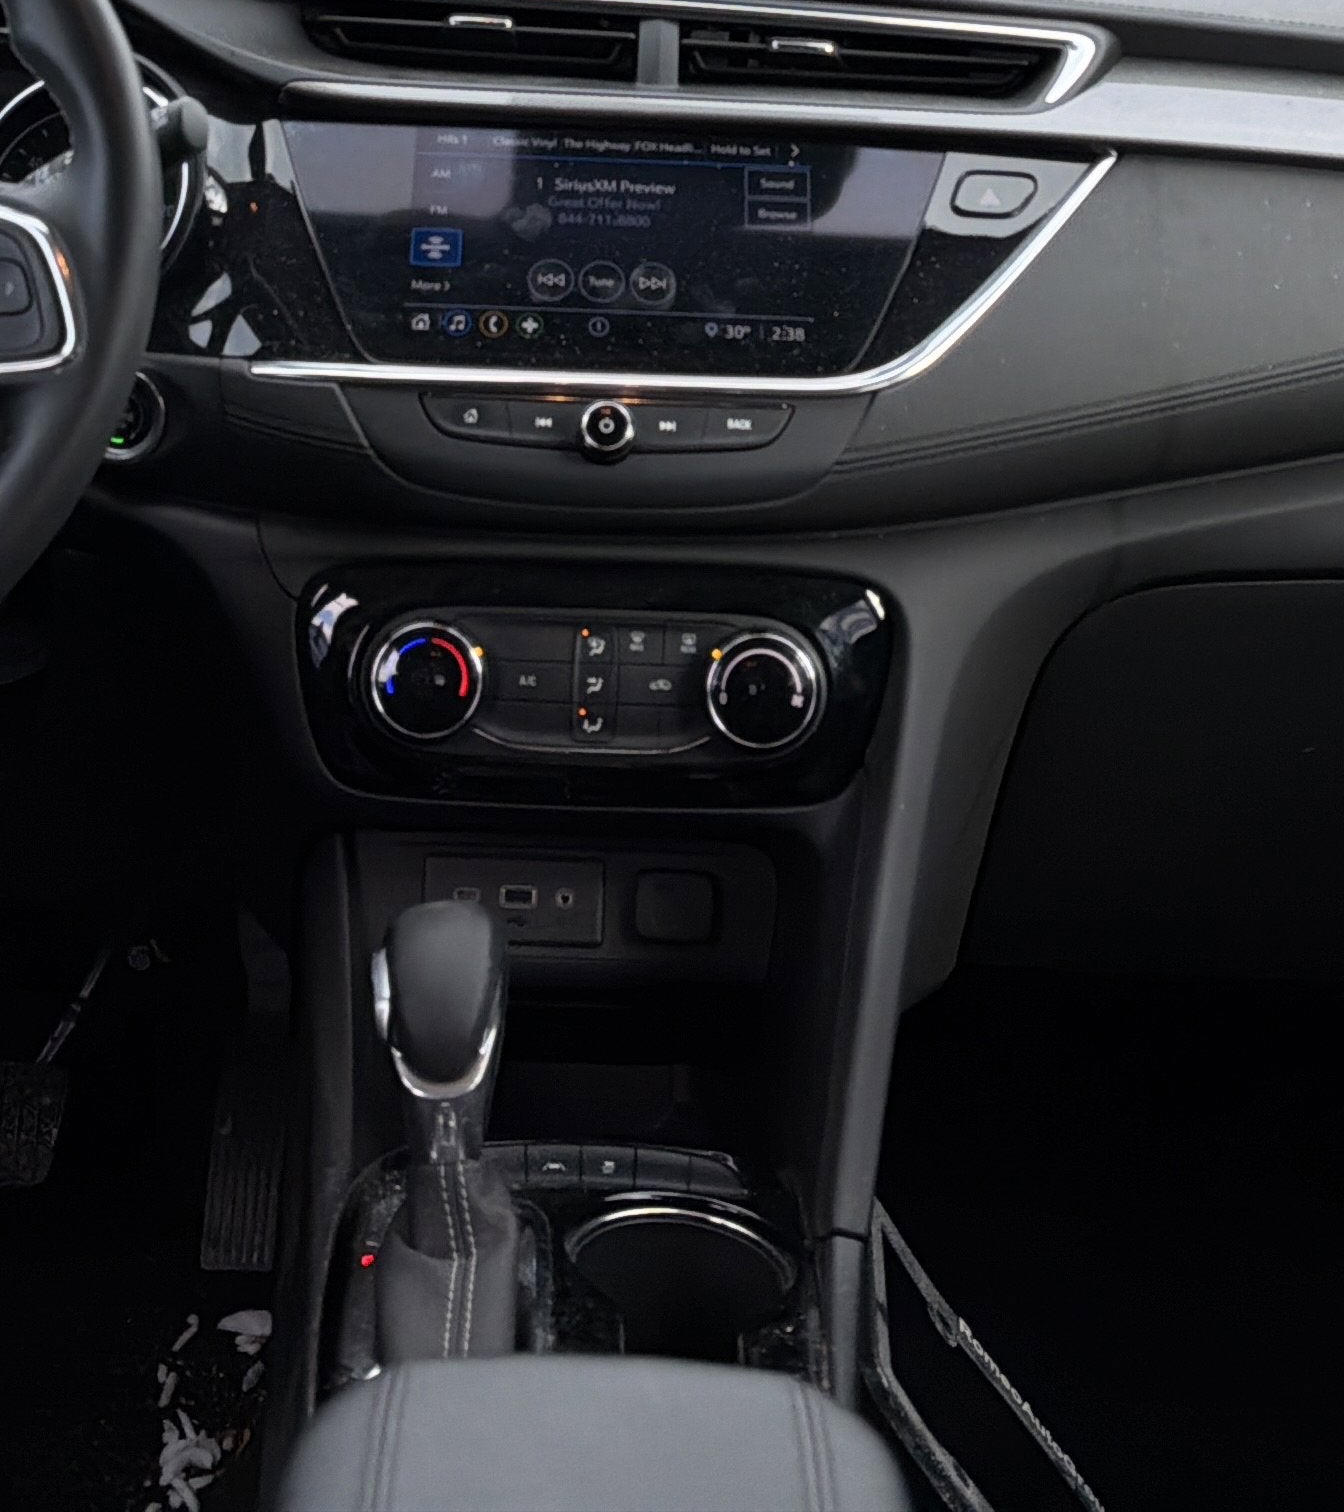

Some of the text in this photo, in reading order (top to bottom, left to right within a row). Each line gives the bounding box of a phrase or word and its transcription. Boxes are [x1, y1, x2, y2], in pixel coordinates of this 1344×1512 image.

[431, 168, 452, 179] AM
[555, 176, 617, 193] SiriusXM
[620, 179, 676, 195] Preview
[430, 204, 449, 216] FM
[410, 278, 440, 292] More
[588, 274, 616, 288] Tune
[725, 323, 806, 342] 30° 2:38
[726, 417, 753, 431] BACK
[518, 673, 538, 687] A/C
